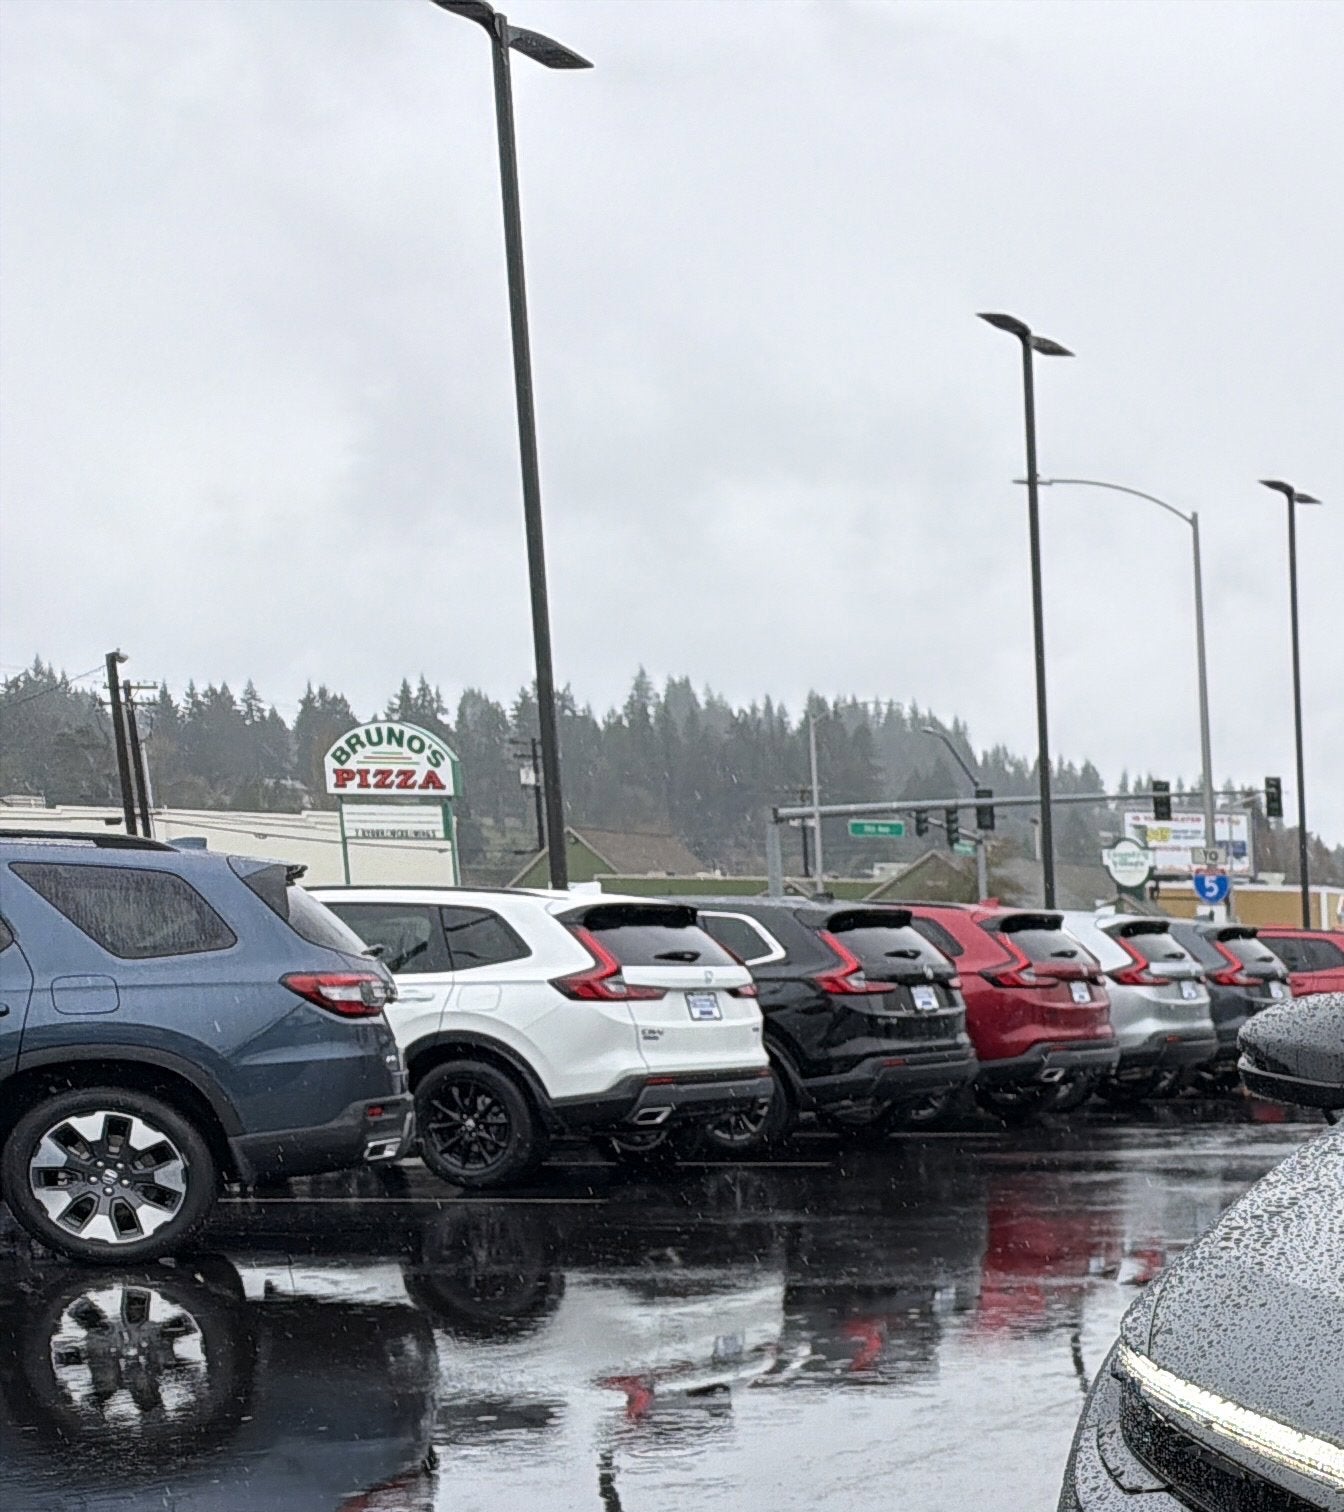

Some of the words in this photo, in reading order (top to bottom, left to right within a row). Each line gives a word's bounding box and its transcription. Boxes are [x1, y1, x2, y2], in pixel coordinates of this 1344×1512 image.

[330, 726, 446, 767] BRUNO'S
[332, 768, 447, 790] PIZZA
[1204, 876, 1219, 898] 5
